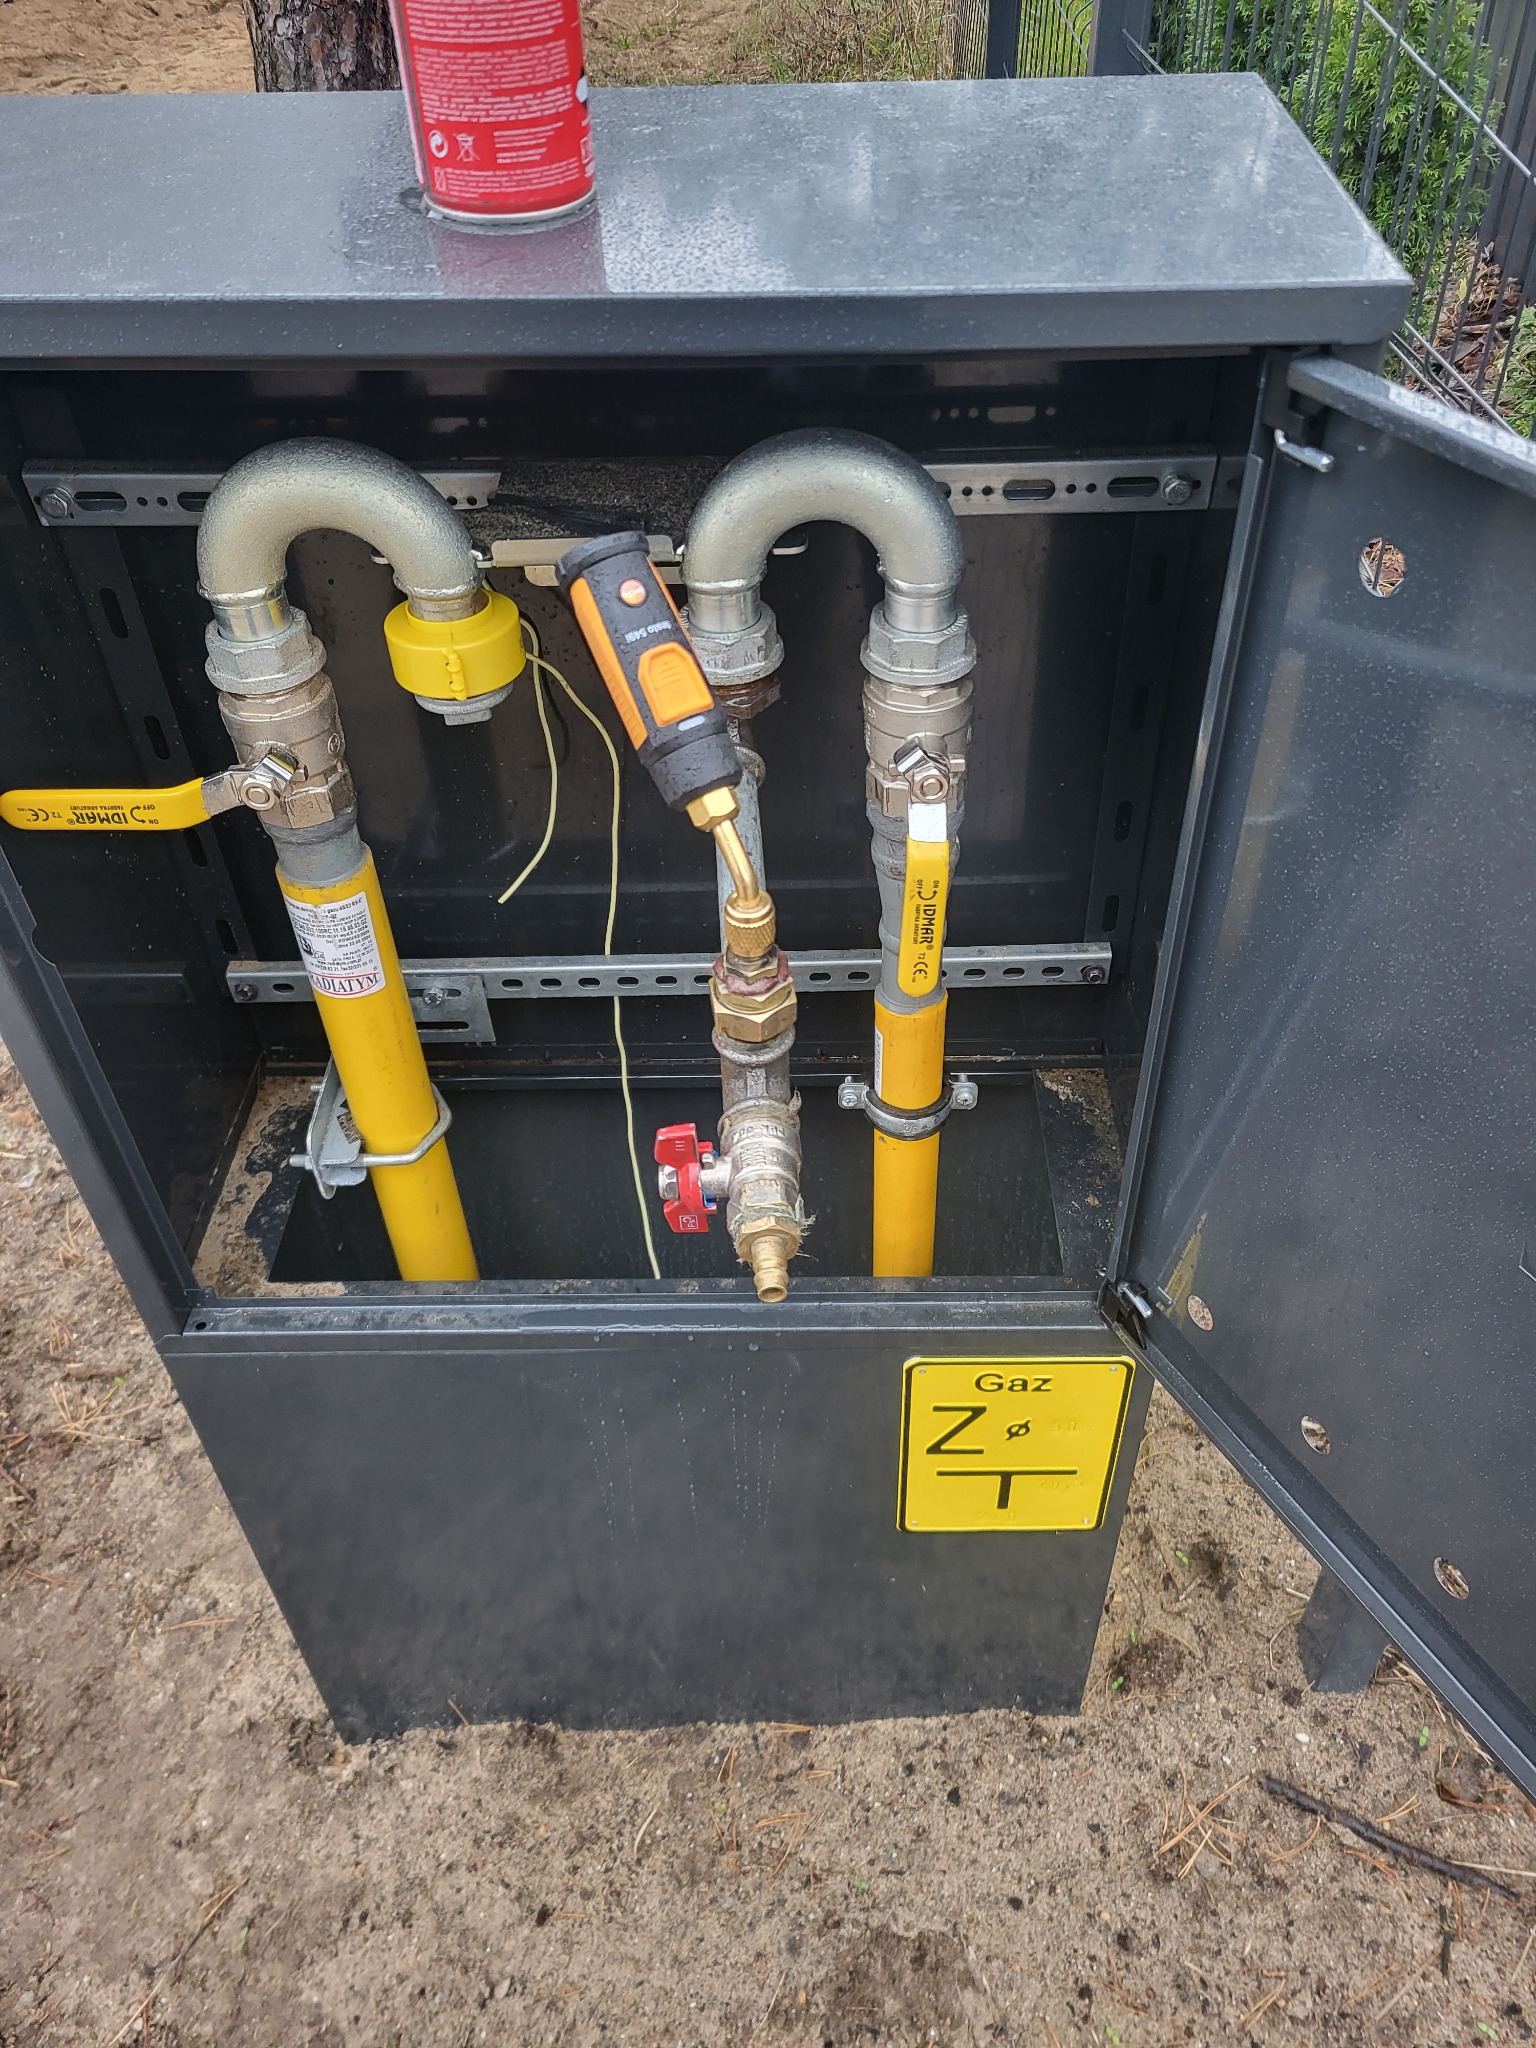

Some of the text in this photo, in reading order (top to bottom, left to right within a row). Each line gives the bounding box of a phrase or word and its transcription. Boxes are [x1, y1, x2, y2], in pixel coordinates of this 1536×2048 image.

[647, 620, 672, 634] testo
[51, 811, 62, 819] T2
[932, 880, 940, 889] ON
[918, 952, 926, 960] T2
[309, 971, 379, 992] RADIATYM
[974, 1372, 1054, 1394] Gaz
[925, 1404, 988, 1456] Z
